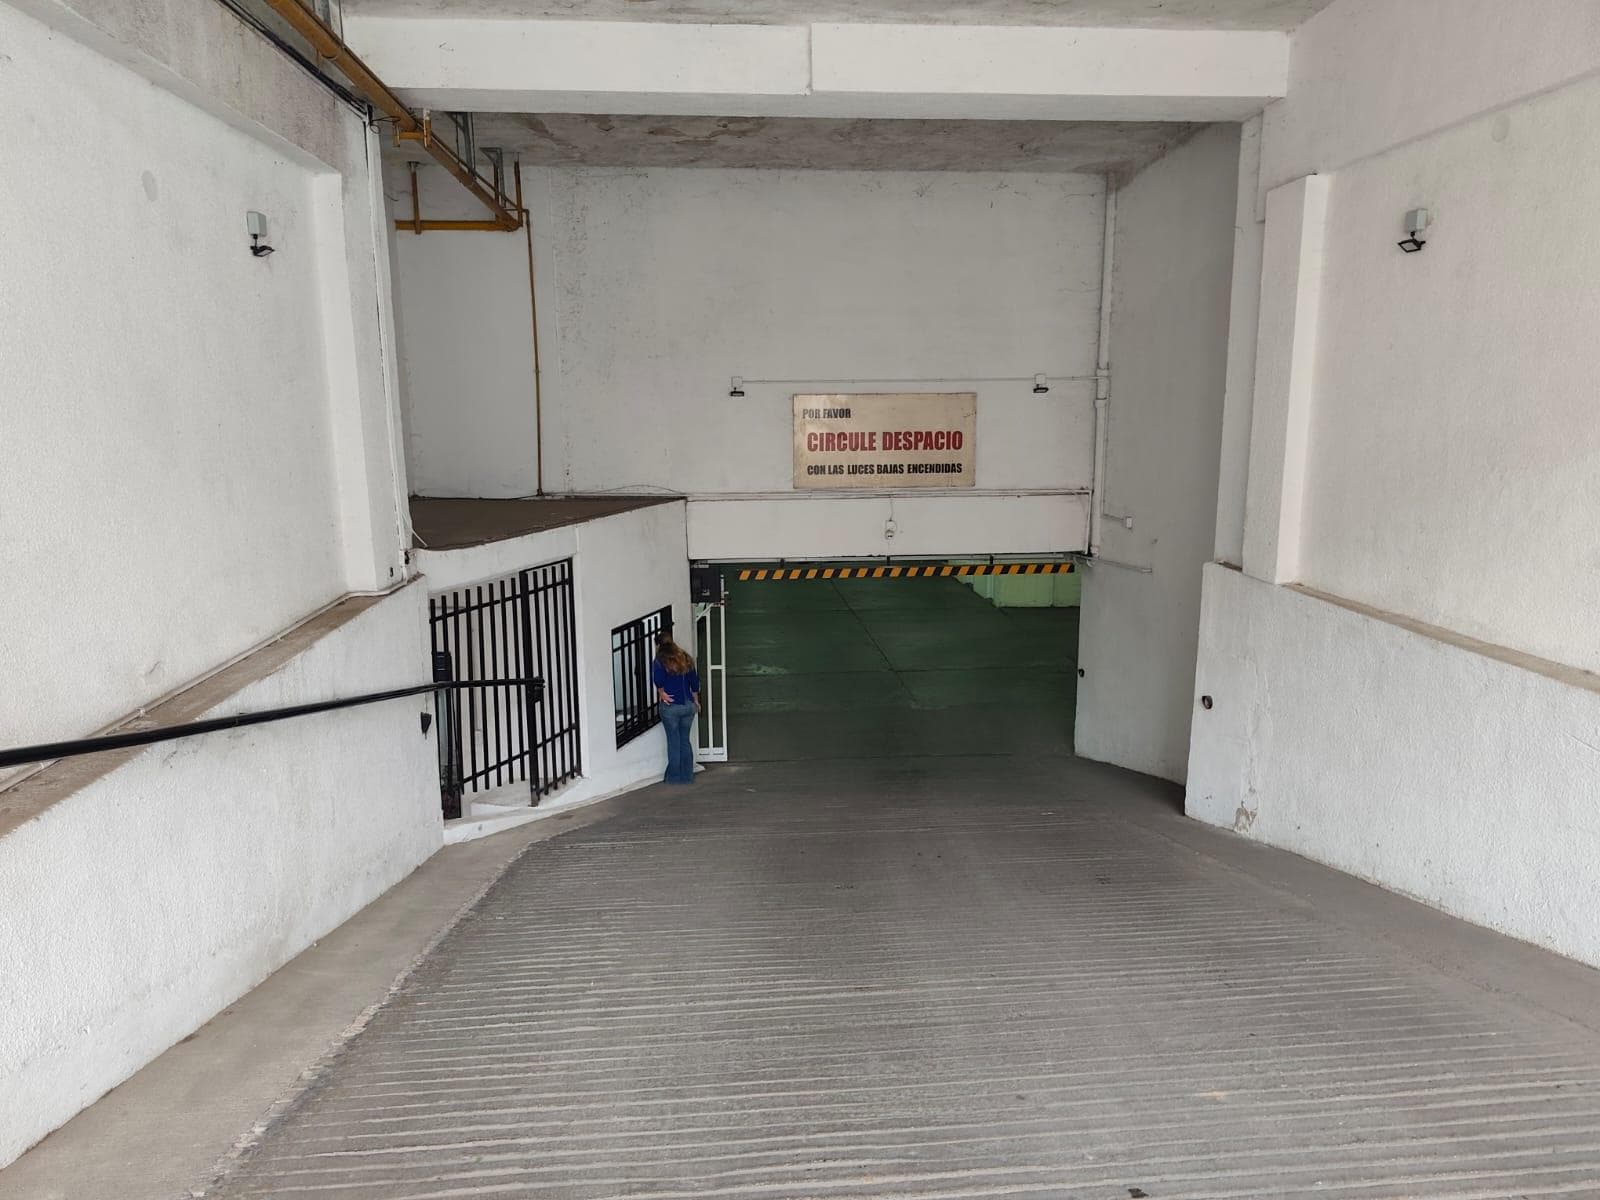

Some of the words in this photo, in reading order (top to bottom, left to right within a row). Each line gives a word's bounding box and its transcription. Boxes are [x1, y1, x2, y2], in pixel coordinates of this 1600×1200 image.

[802, 408, 821, 419] POR
[822, 408, 851, 419] FAVOR
[807, 431, 876, 452] CIRCULE
[882, 430, 963, 451] DESPACIO
[807, 464, 826, 475] CON
[828, 464, 844, 475] LAS
[847, 464, 875, 475] LUCES
[877, 463, 904, 475] BAJAS
[907, 463, 963, 474] ENCENDIDAS
